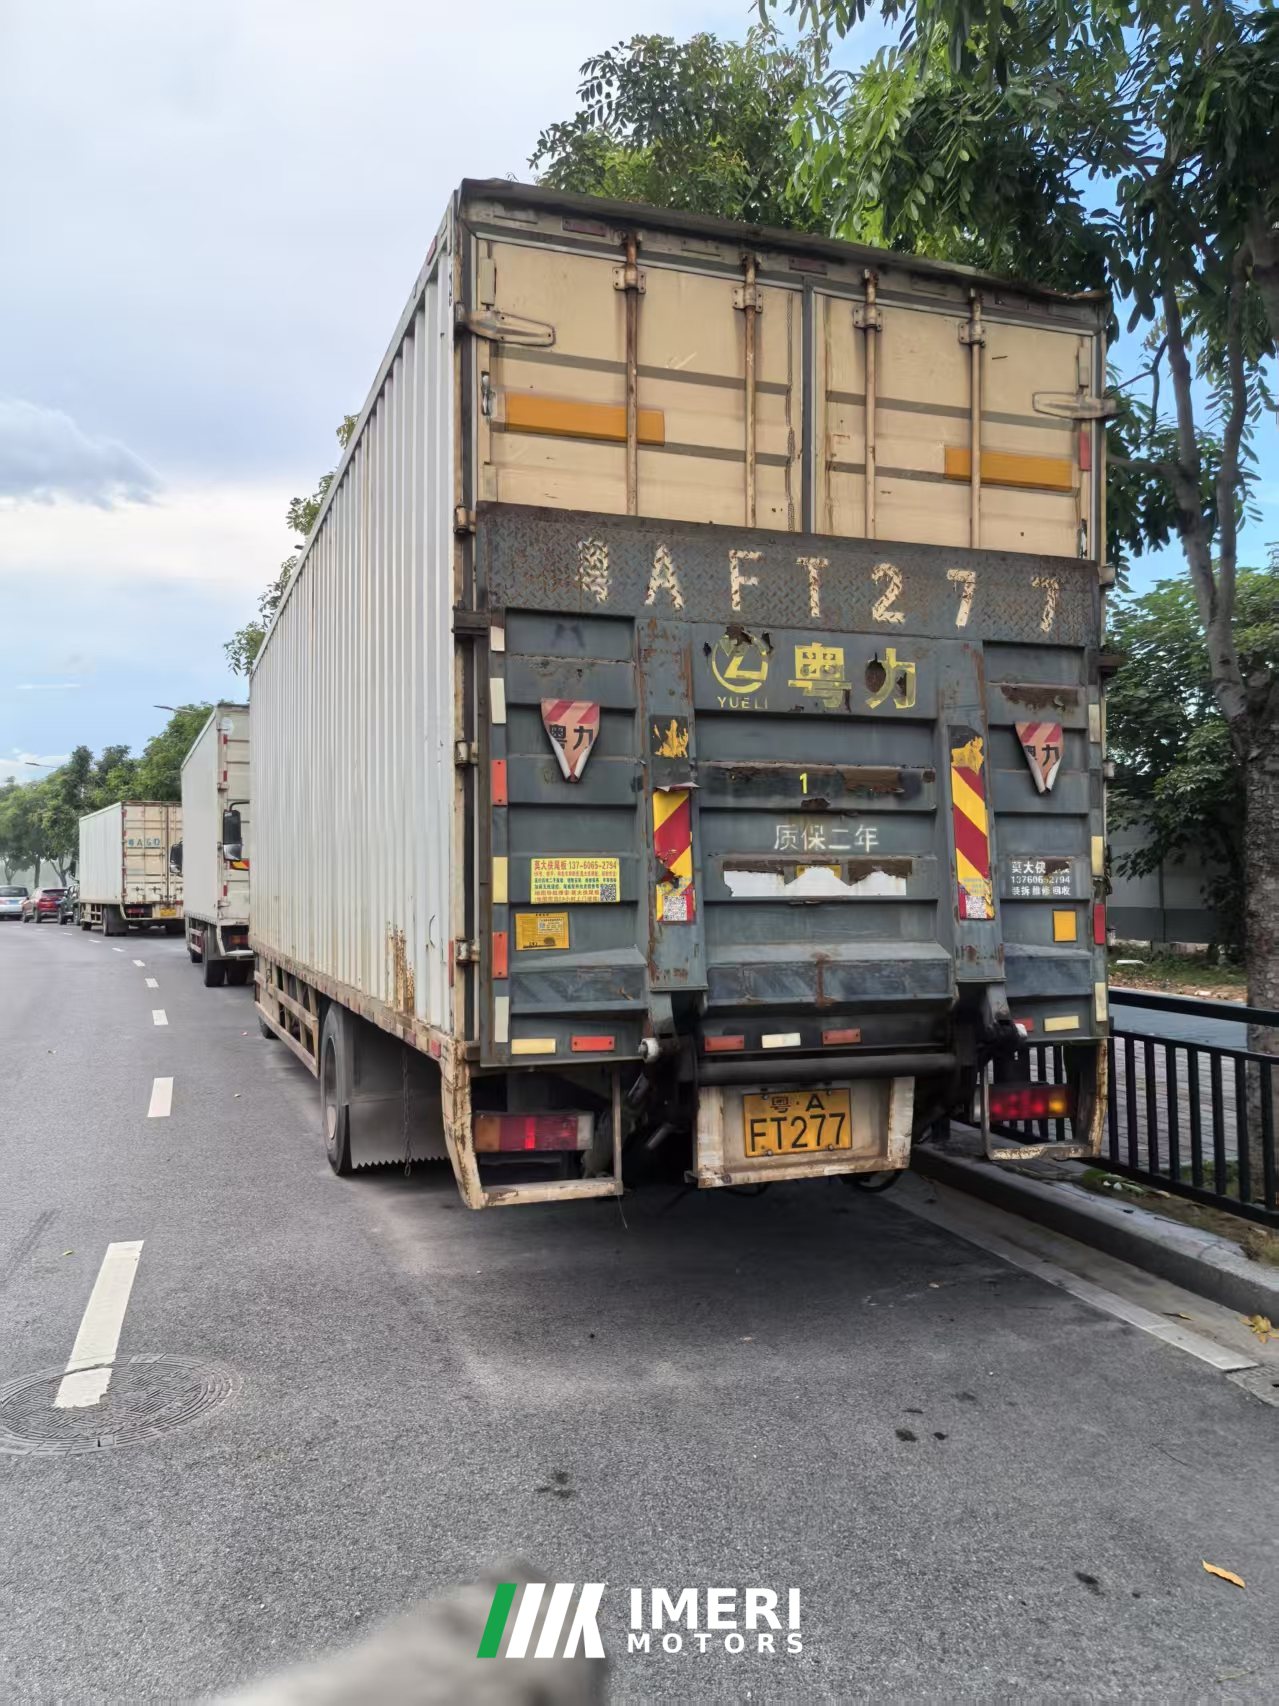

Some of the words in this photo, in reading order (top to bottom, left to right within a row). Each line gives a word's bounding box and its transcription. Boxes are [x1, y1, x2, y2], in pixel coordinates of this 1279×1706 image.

[788, 642, 916, 709] 粤力
[799, 772, 808, 794] 1
[773, 824, 879, 852] 质保二年
[1011, 860, 1070, 874] 莫大侠
[1052, 885, 1071, 896] 回收
[750, 1112, 846, 1152] FT277
